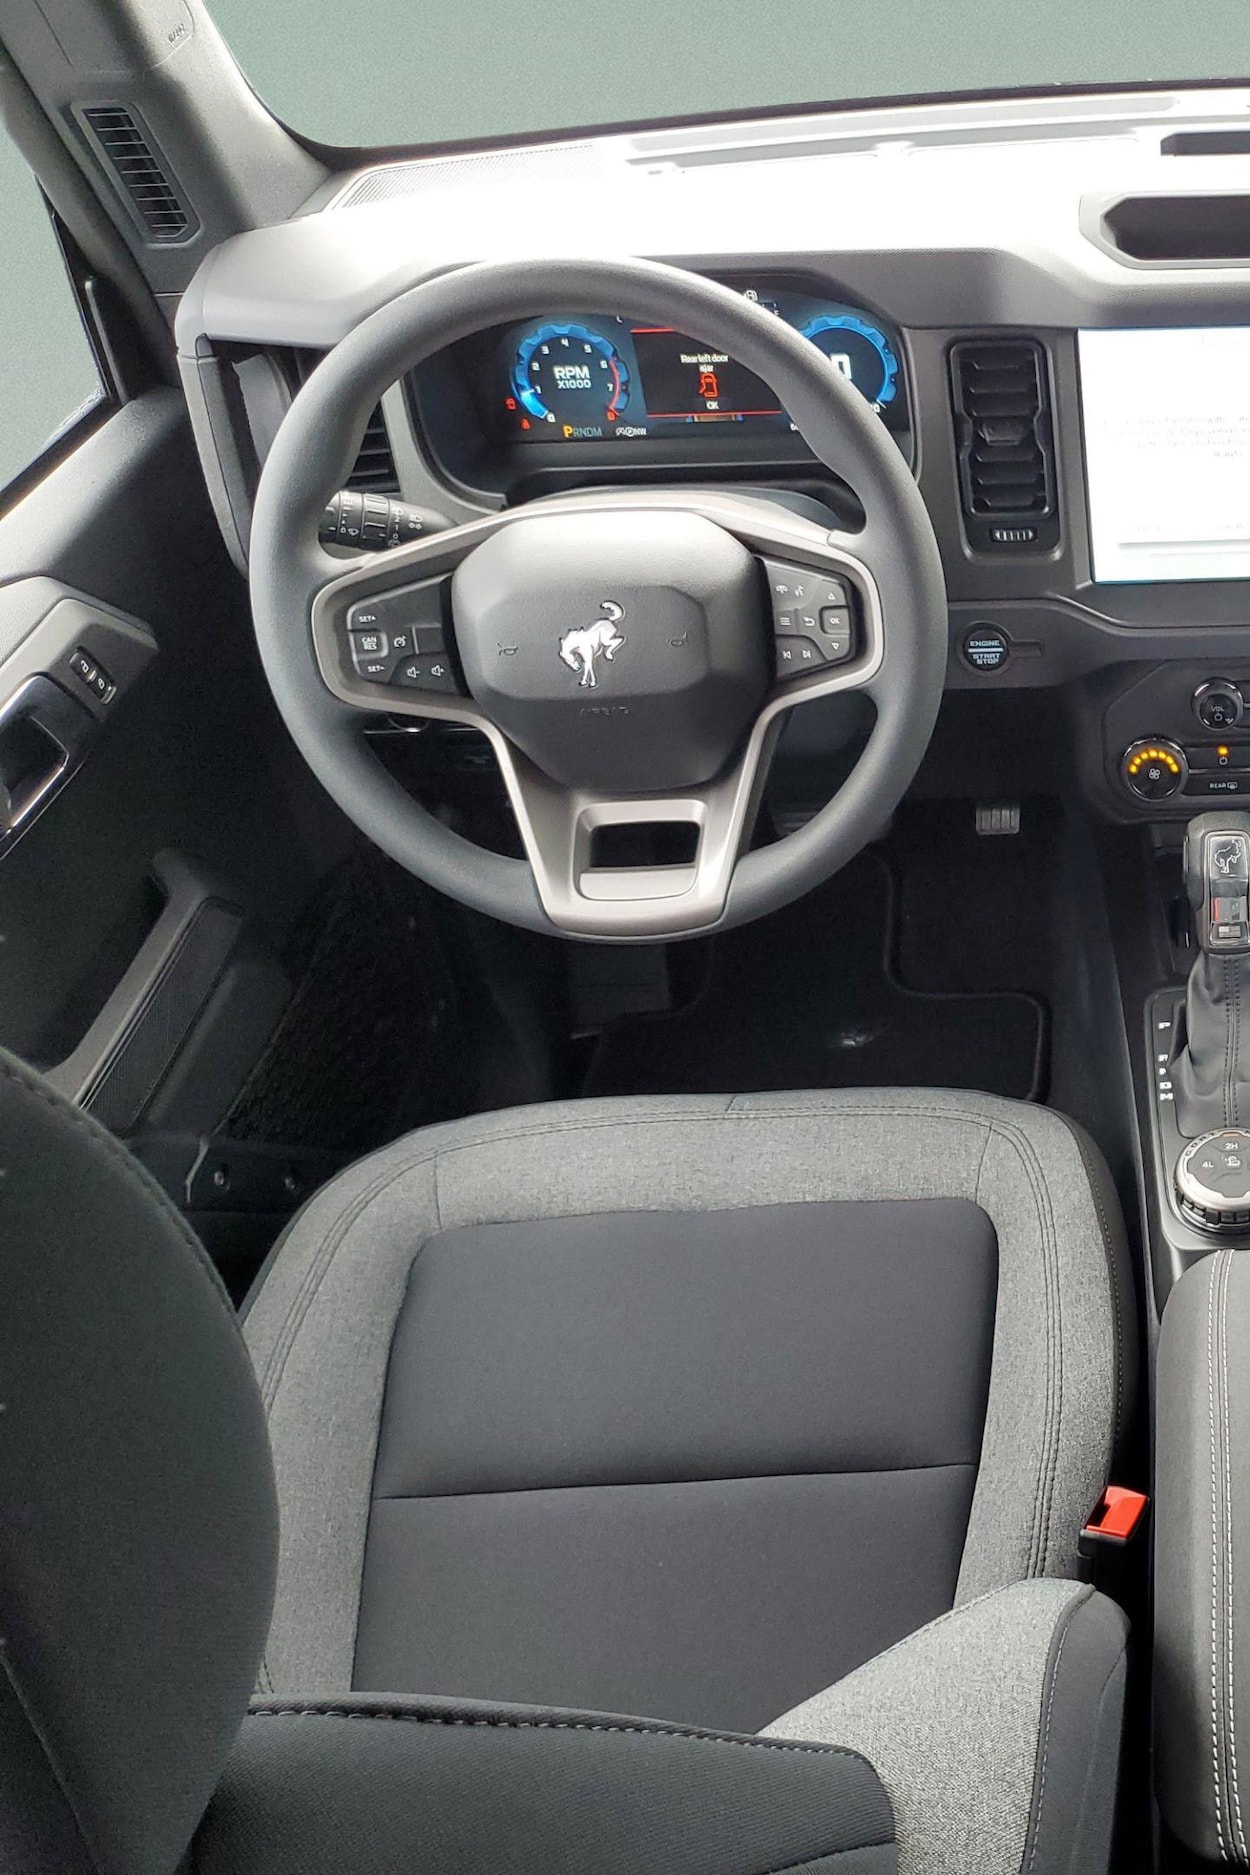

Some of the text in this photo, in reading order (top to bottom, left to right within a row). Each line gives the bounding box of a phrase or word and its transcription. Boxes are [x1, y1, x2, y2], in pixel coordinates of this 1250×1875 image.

[561, 337, 569, 347] 4
[541, 345, 549, 355] 3
[584, 344, 592, 353] 5
[698, 354, 711, 362] left
[712, 353, 729, 362] door
[531, 362, 540, 371] 2
[600, 360, 608, 369] 6
[699, 364, 713, 373] ajar
[553, 365, 590, 379] RPM
[557, 379, 592, 389] X1000
[607, 383, 614, 392] 7
[706, 401, 720, 409] OK
[829, 617, 841, 625] OK
[361, 636, 378, 644] CAN
[363, 643, 378, 651] RES
[1158, 1021, 1171, 1030] P
[1159, 1081, 1173, 1090] D
[1160, 1093, 1174, 1101] M
[1224, 1142, 1239, 1150] 2H
